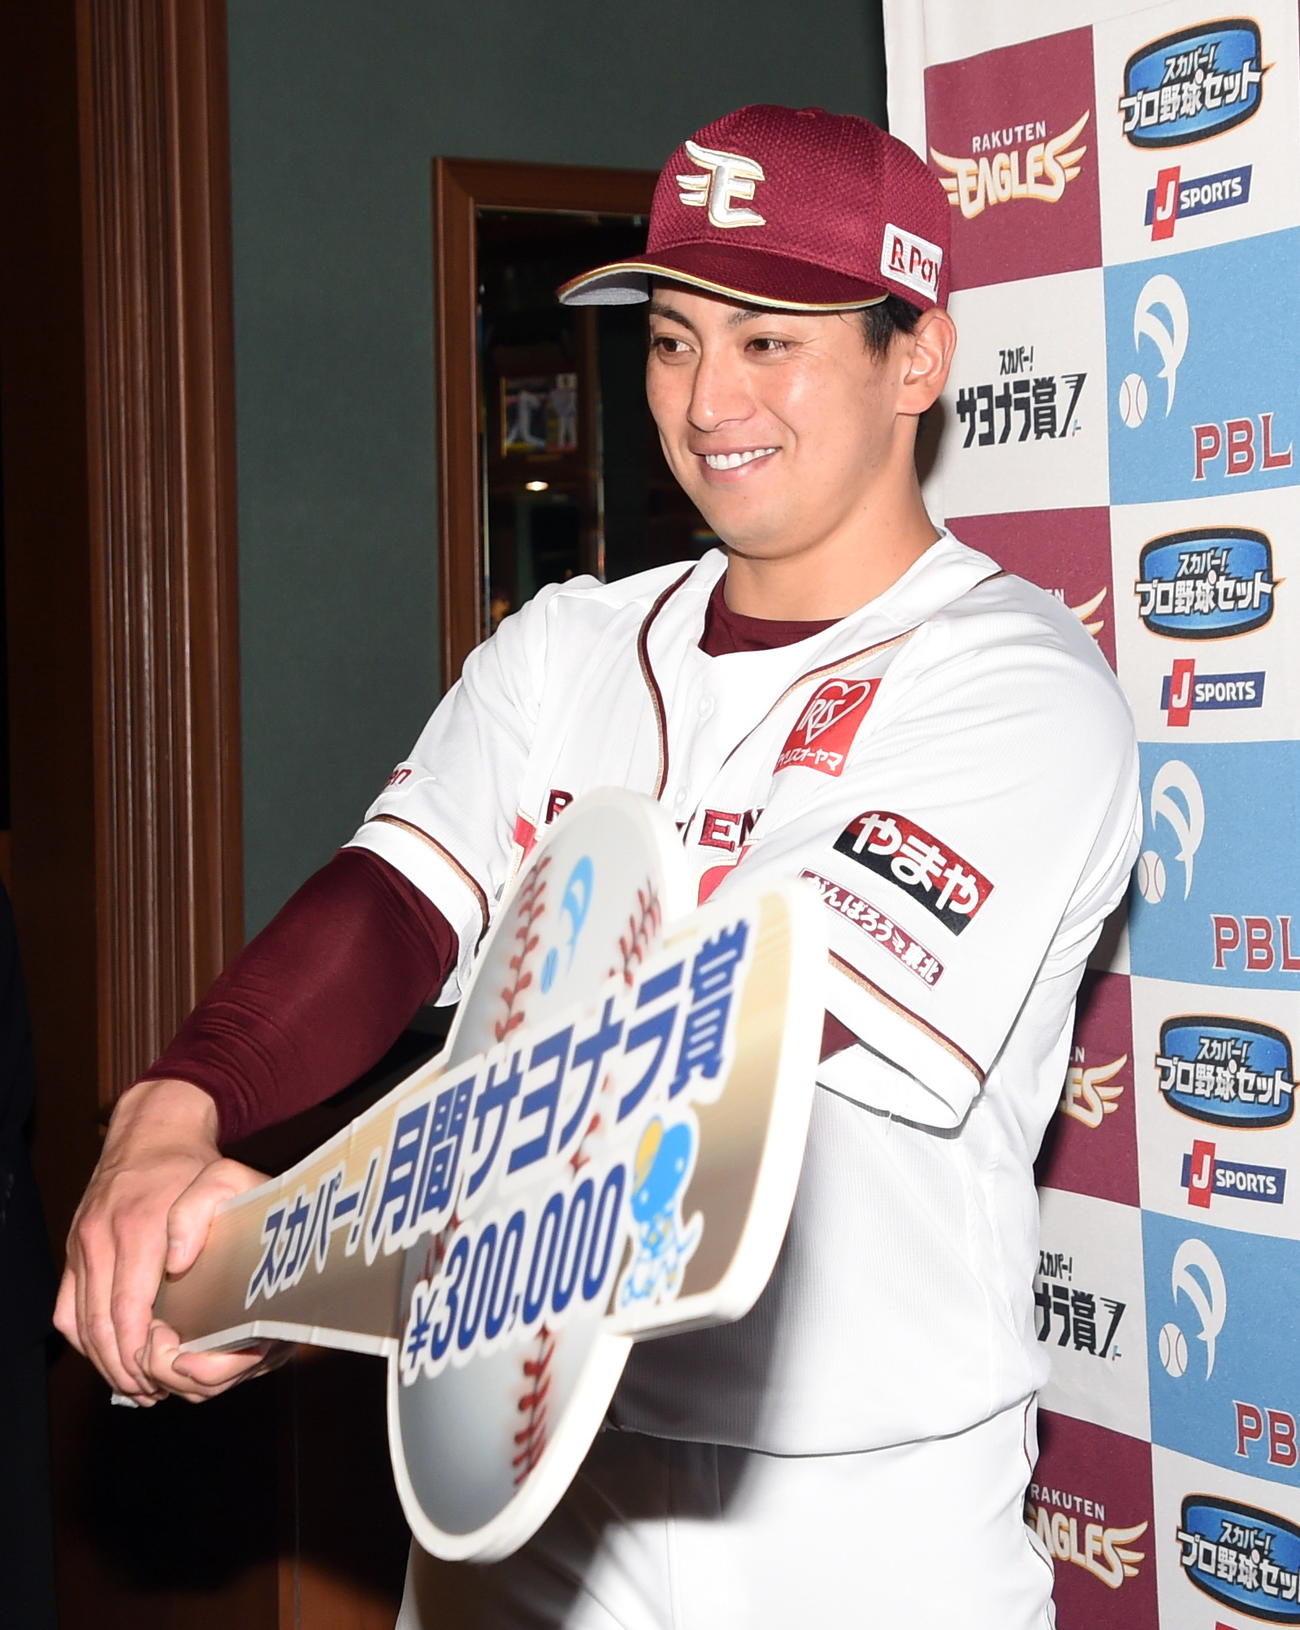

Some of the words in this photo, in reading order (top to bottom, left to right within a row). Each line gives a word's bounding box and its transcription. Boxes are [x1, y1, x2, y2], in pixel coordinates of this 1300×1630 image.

[1119, 59, 1262, 133] プロ野球セット
[972, 120, 1047, 154] RAKUTEN
[931, 118, 1089, 219] EAGLES
[1180, 176, 1243, 211] SPORTS
[1190, 412, 1293, 482] PBL
[1135, 570, 1274, 616] プロ野球セット
[1194, 680, 1256, 703] SPORTS
[852, 813, 980, 915] やまや
[1209, 914, 1300, 973] PBL
[1156, 1056, 1294, 1106] プロ野球セット
[1215, 1168, 1277, 1195] SPORTS
[407, 1162, 627, 1366] ¥300,000
[1232, 1400, 1299, 1468] PB
[1030, 1483, 1105, 1521] RAKUTEN
[1178, 1530, 1300, 1603] プロ野球セッ
